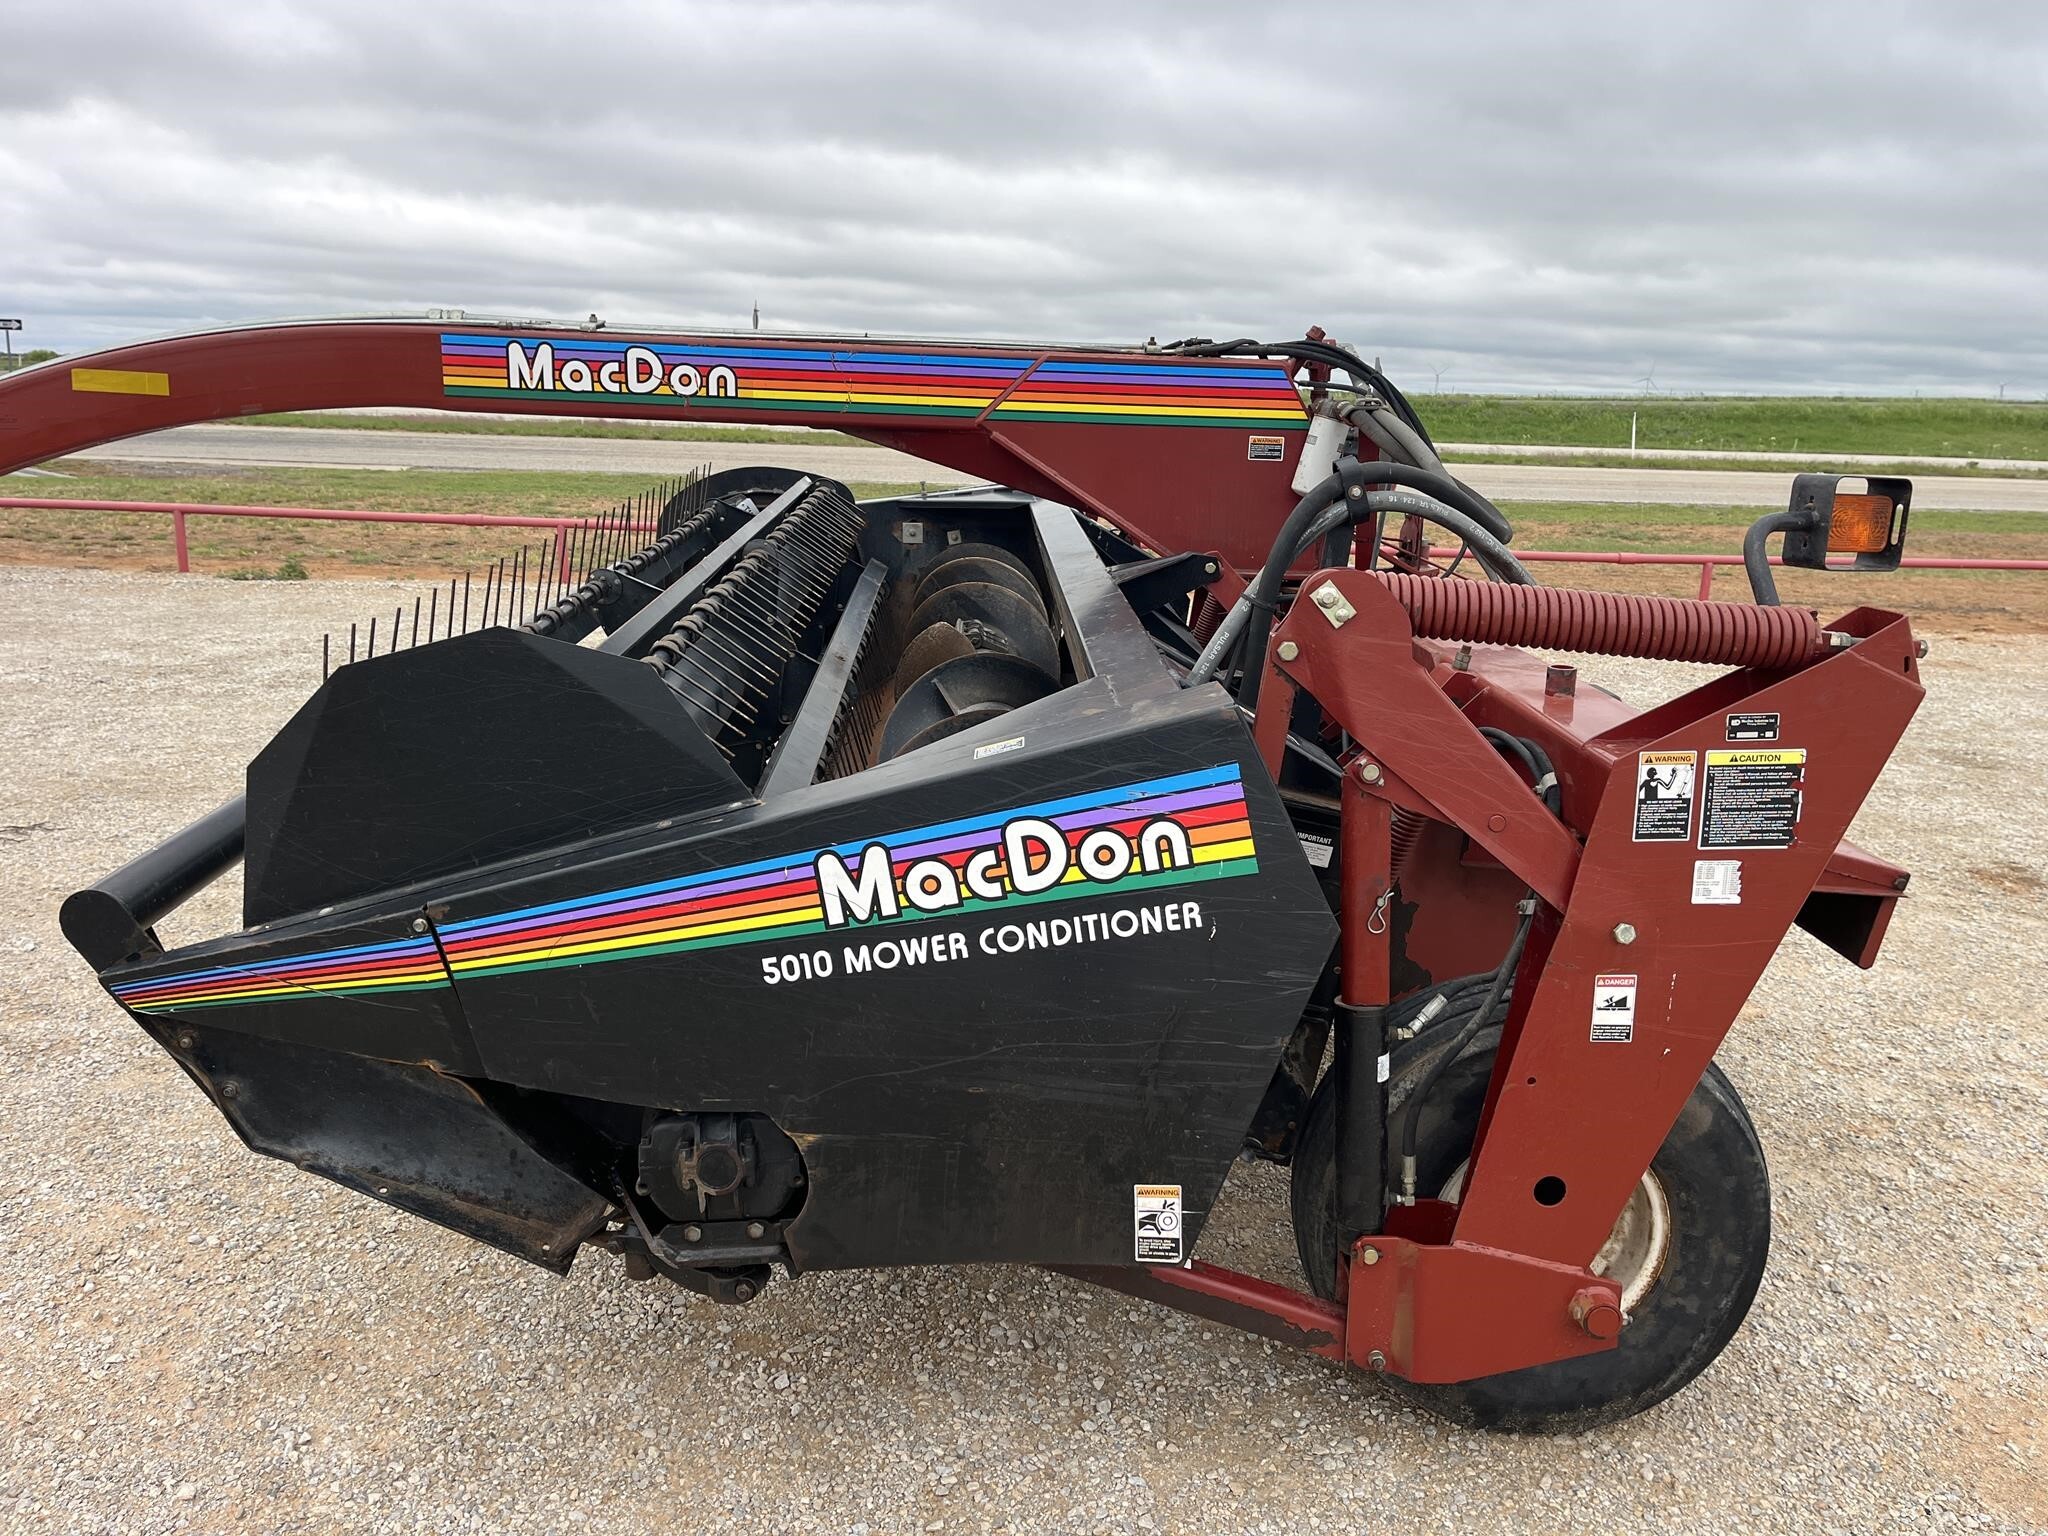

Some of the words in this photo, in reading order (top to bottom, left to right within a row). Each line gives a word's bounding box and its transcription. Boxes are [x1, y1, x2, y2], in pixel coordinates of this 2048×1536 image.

[506, 341, 738, 398] MacDon
[1208, 631, 1230, 661] PULSAR
[1654, 755, 1692, 763] WARNING
[1738, 754, 1782, 763] CAUTION
[817, 818, 1191, 928] MacDon
[760, 950, 833, 985] 5010
[843, 932, 969, 975] MOWER
[978, 901, 1203, 955] CONDITIONER
[1604, 978, 1634, 986] DANGER
[1143, 1188, 1179, 1197] WARNING
